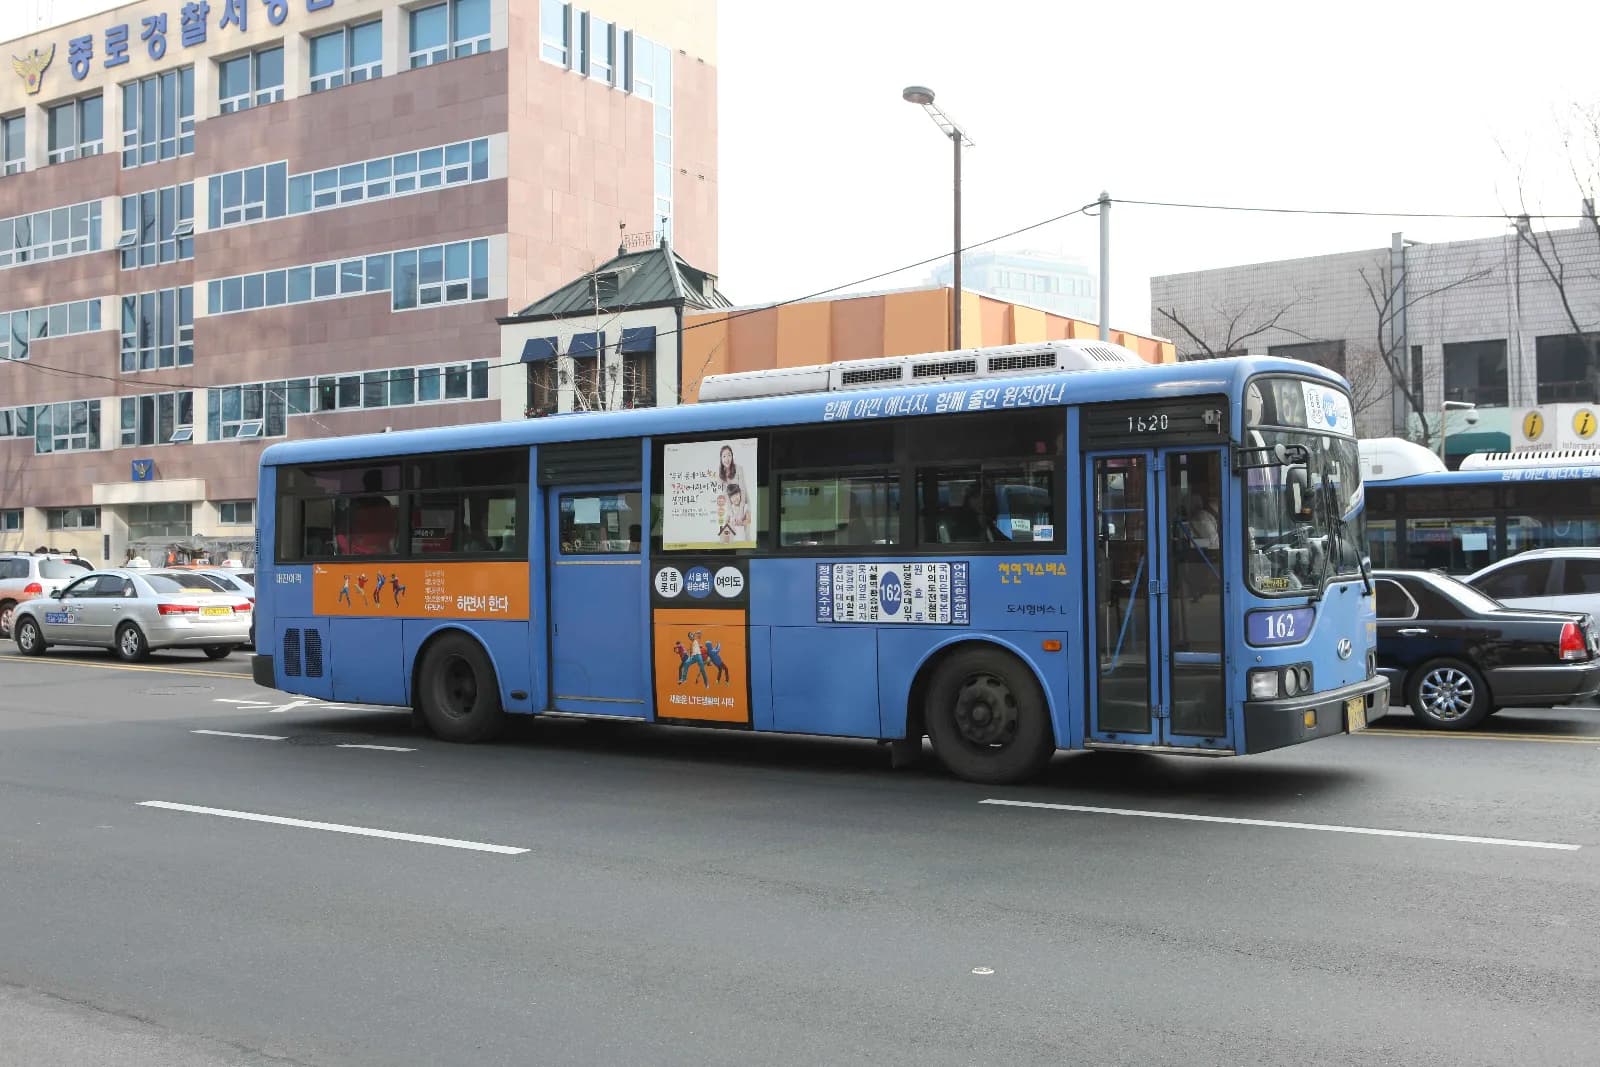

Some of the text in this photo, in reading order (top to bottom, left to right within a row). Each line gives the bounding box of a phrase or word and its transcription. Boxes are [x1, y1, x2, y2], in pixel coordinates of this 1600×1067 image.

[823, 399, 851, 420] 함께
[854, 398, 881, 417] 아낀
[935, 390, 967, 412] 함께
[967, 387, 1000, 409] 줄인
[1127, 414, 1169, 432] 1620
[688, 572, 709, 582] 서울역
[716, 576, 742, 588] 여의도
[880, 583, 901, 602] 162
[456, 595, 486, 612] 하면서
[488, 595, 509, 612] 한다
[1265, 613, 1296, 639] 162
